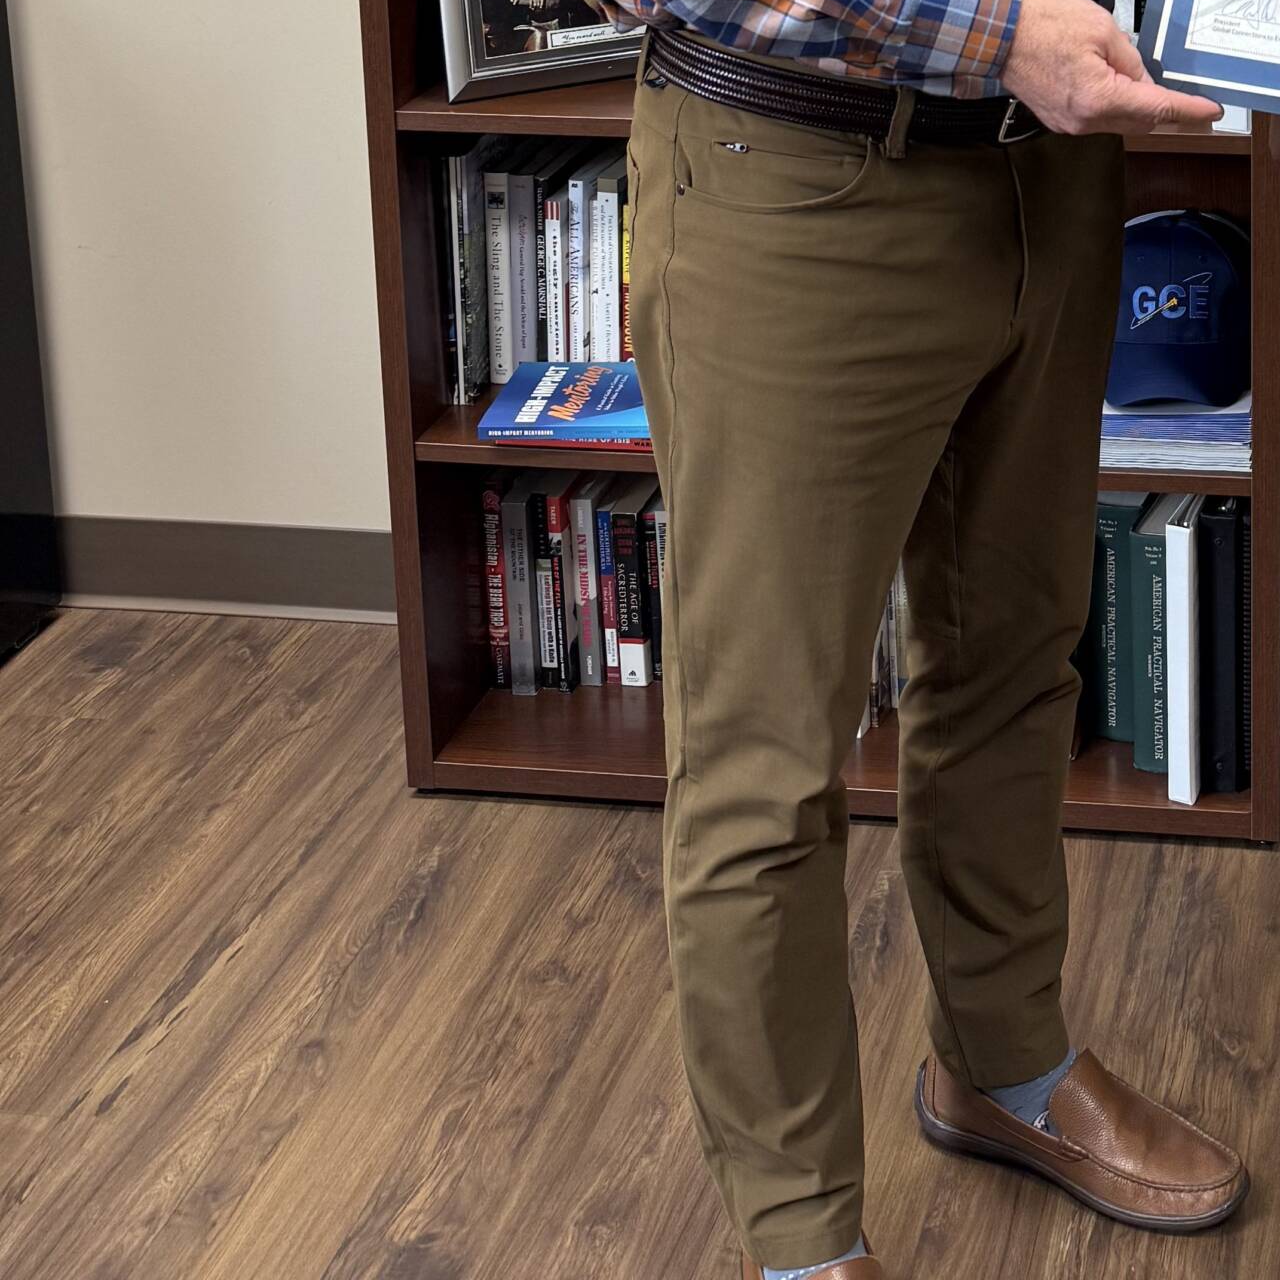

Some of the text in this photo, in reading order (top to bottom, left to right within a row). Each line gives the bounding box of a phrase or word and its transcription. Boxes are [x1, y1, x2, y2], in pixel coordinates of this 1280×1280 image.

[491, 216, 505, 358] The Sling and The Stone
[537, 235, 546, 320] GEORGE C. MARSHALL
[570, 218, 581, 315] ALL AMERICANS
[1132, 284, 1209, 319] GCE
[514, 366, 570, 423] HIGH-IMPACT
[548, 365, 613, 421] Mentoring
[483, 514, 500, 566] Afghanistan
[488, 575, 503, 587] THE
[576, 534, 590, 604] IN THE MIDST
[1106, 548, 1117, 602] AMERICAN
[490, 609, 505, 626] TRAP
[628, 572, 638, 624] THE AGE OF
[1152, 574, 1162, 631] AMERICAN
[1107, 606, 1116, 664] PRACTICAL
[1153, 636, 1163, 693] PRACTICAL
[1107, 666, 1117, 727] NAVIGATOR
[1153, 699, 1164, 760] NAVIGATOR
